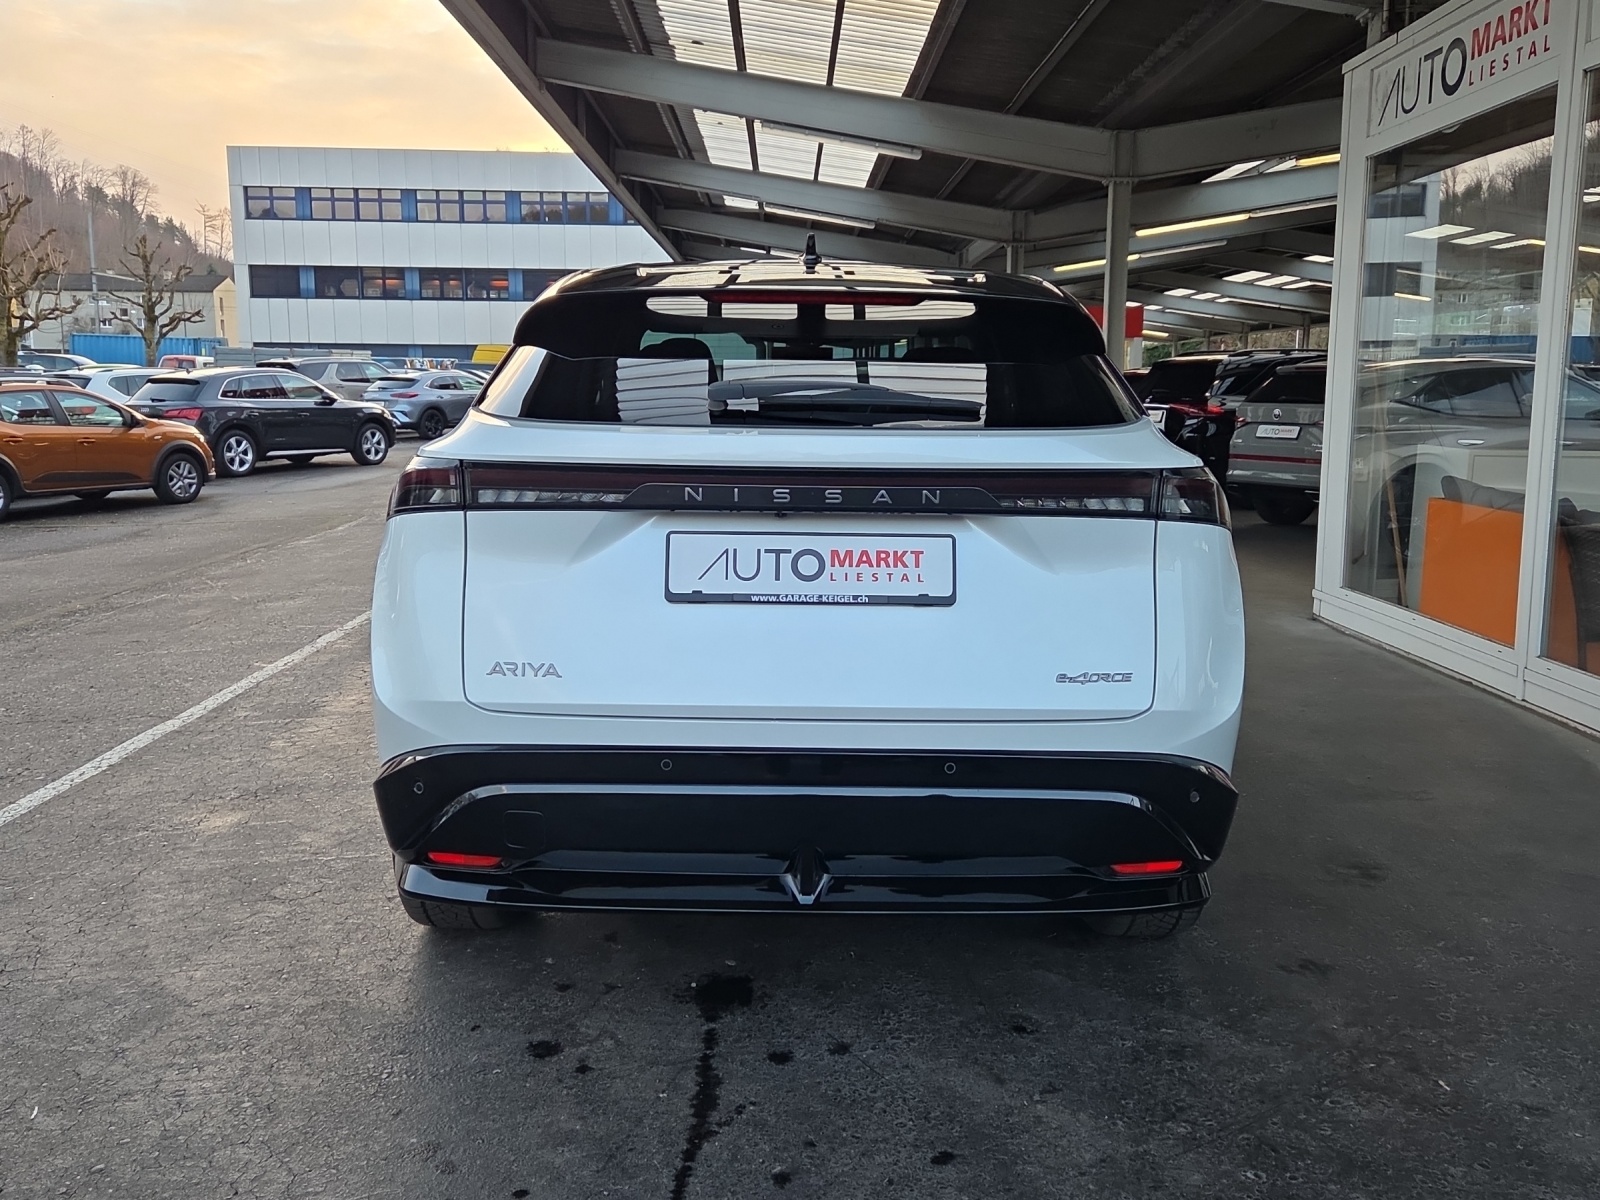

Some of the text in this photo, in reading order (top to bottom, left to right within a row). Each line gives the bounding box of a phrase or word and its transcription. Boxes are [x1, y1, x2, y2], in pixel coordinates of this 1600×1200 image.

[1468, 35, 1551, 87] LIESTAL
[1378, 37, 1468, 127] AUTO
[1260, 428, 1280, 436] AUTO
[684, 486, 941, 505] NISSAN
[697, 547, 925, 582] AUTO MARKT
[830, 572, 925, 583] LIESTAL
[750, 594, 869, 604] www.GARAGE-KEIGEL.ch
[486, 660, 563, 679] ARIYA
